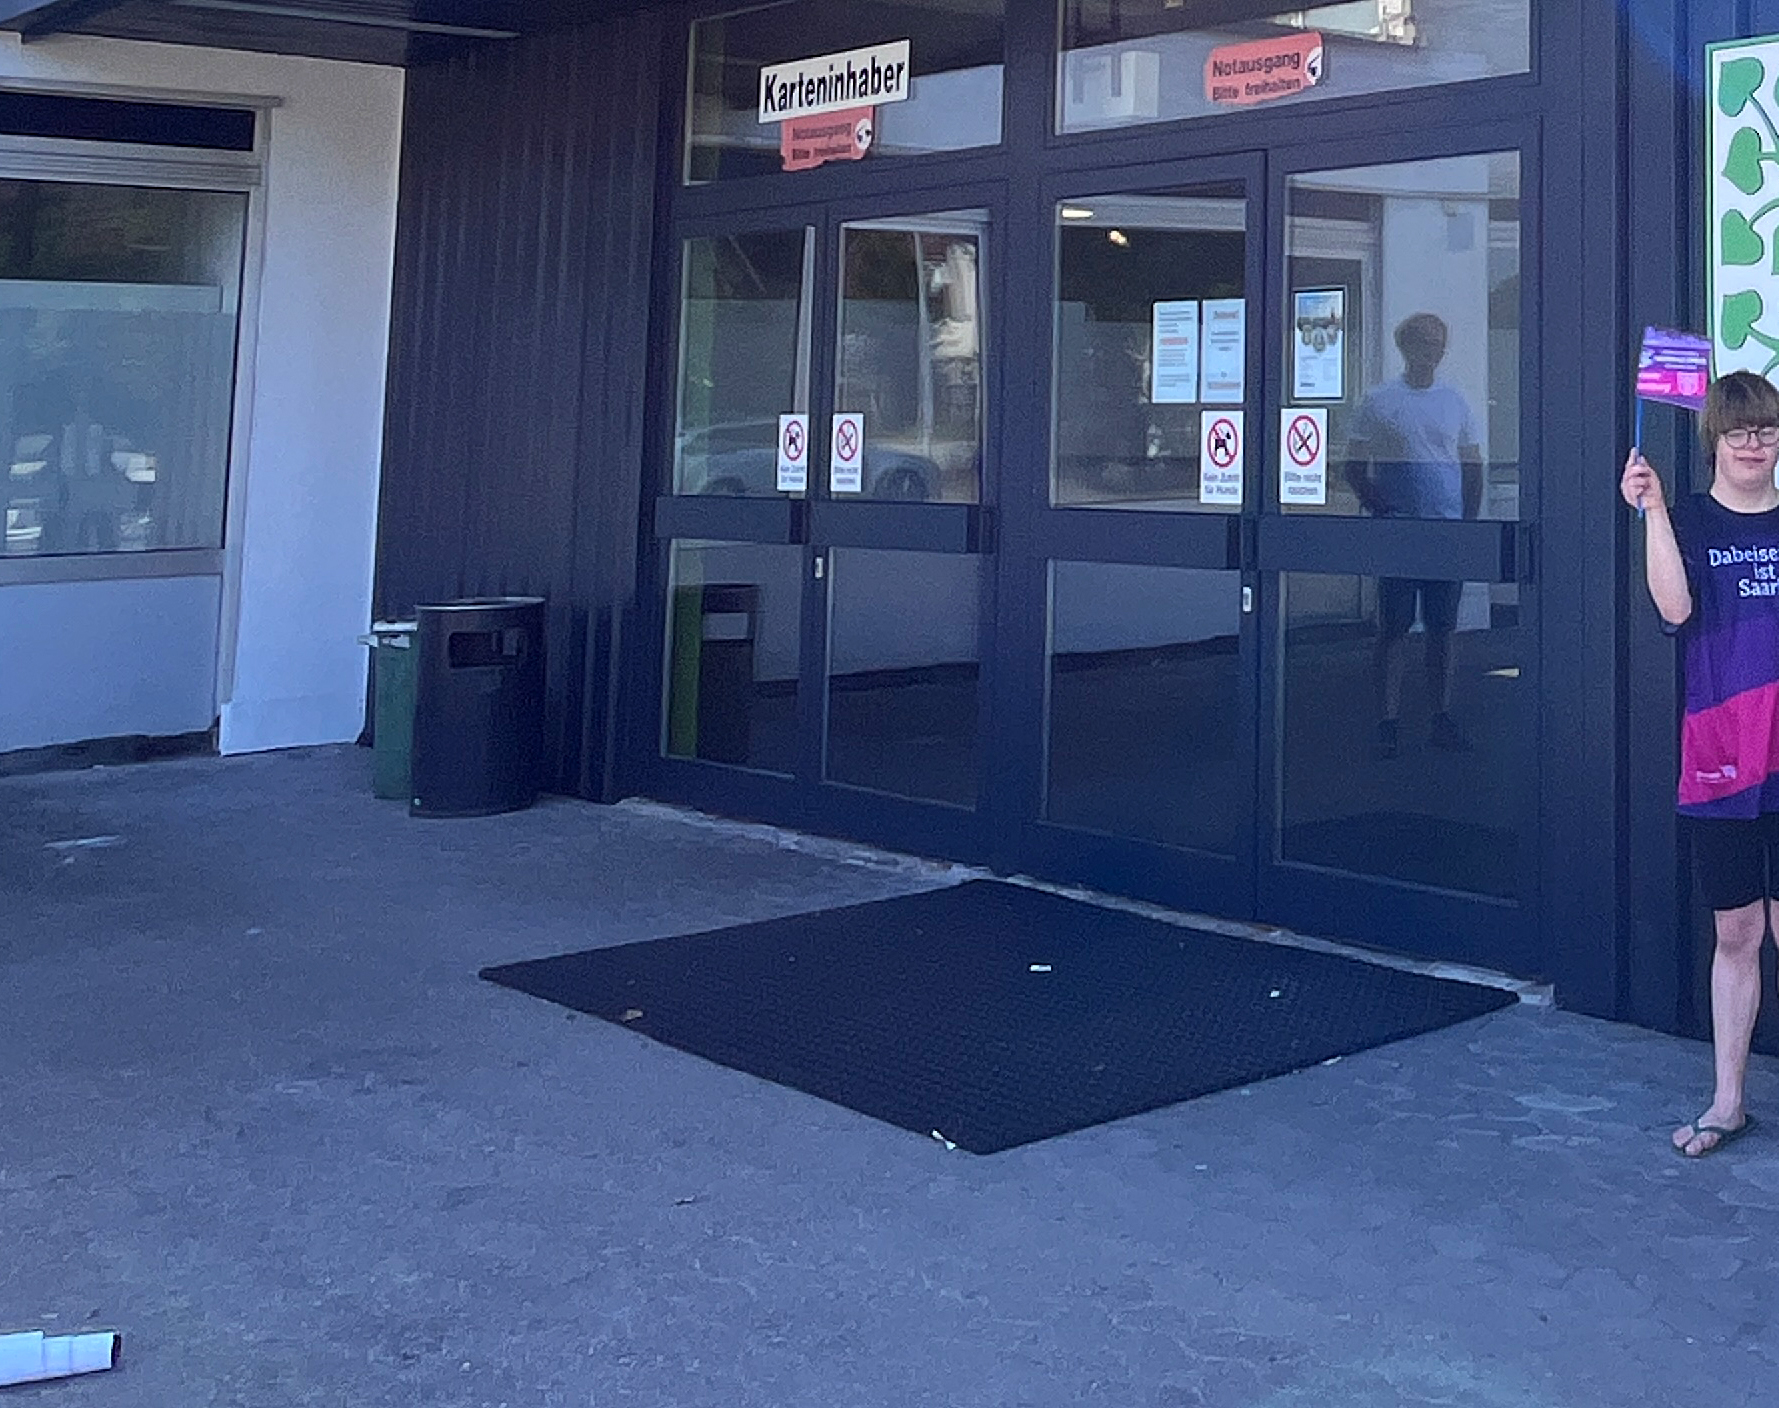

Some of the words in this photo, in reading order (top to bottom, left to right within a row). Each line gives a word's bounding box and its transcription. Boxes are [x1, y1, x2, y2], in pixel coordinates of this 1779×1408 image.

[1213, 52, 1300, 77] Notausgang
[763, 56, 905, 113] Karteninhaber
[1753, 563, 1776, 579] ist
